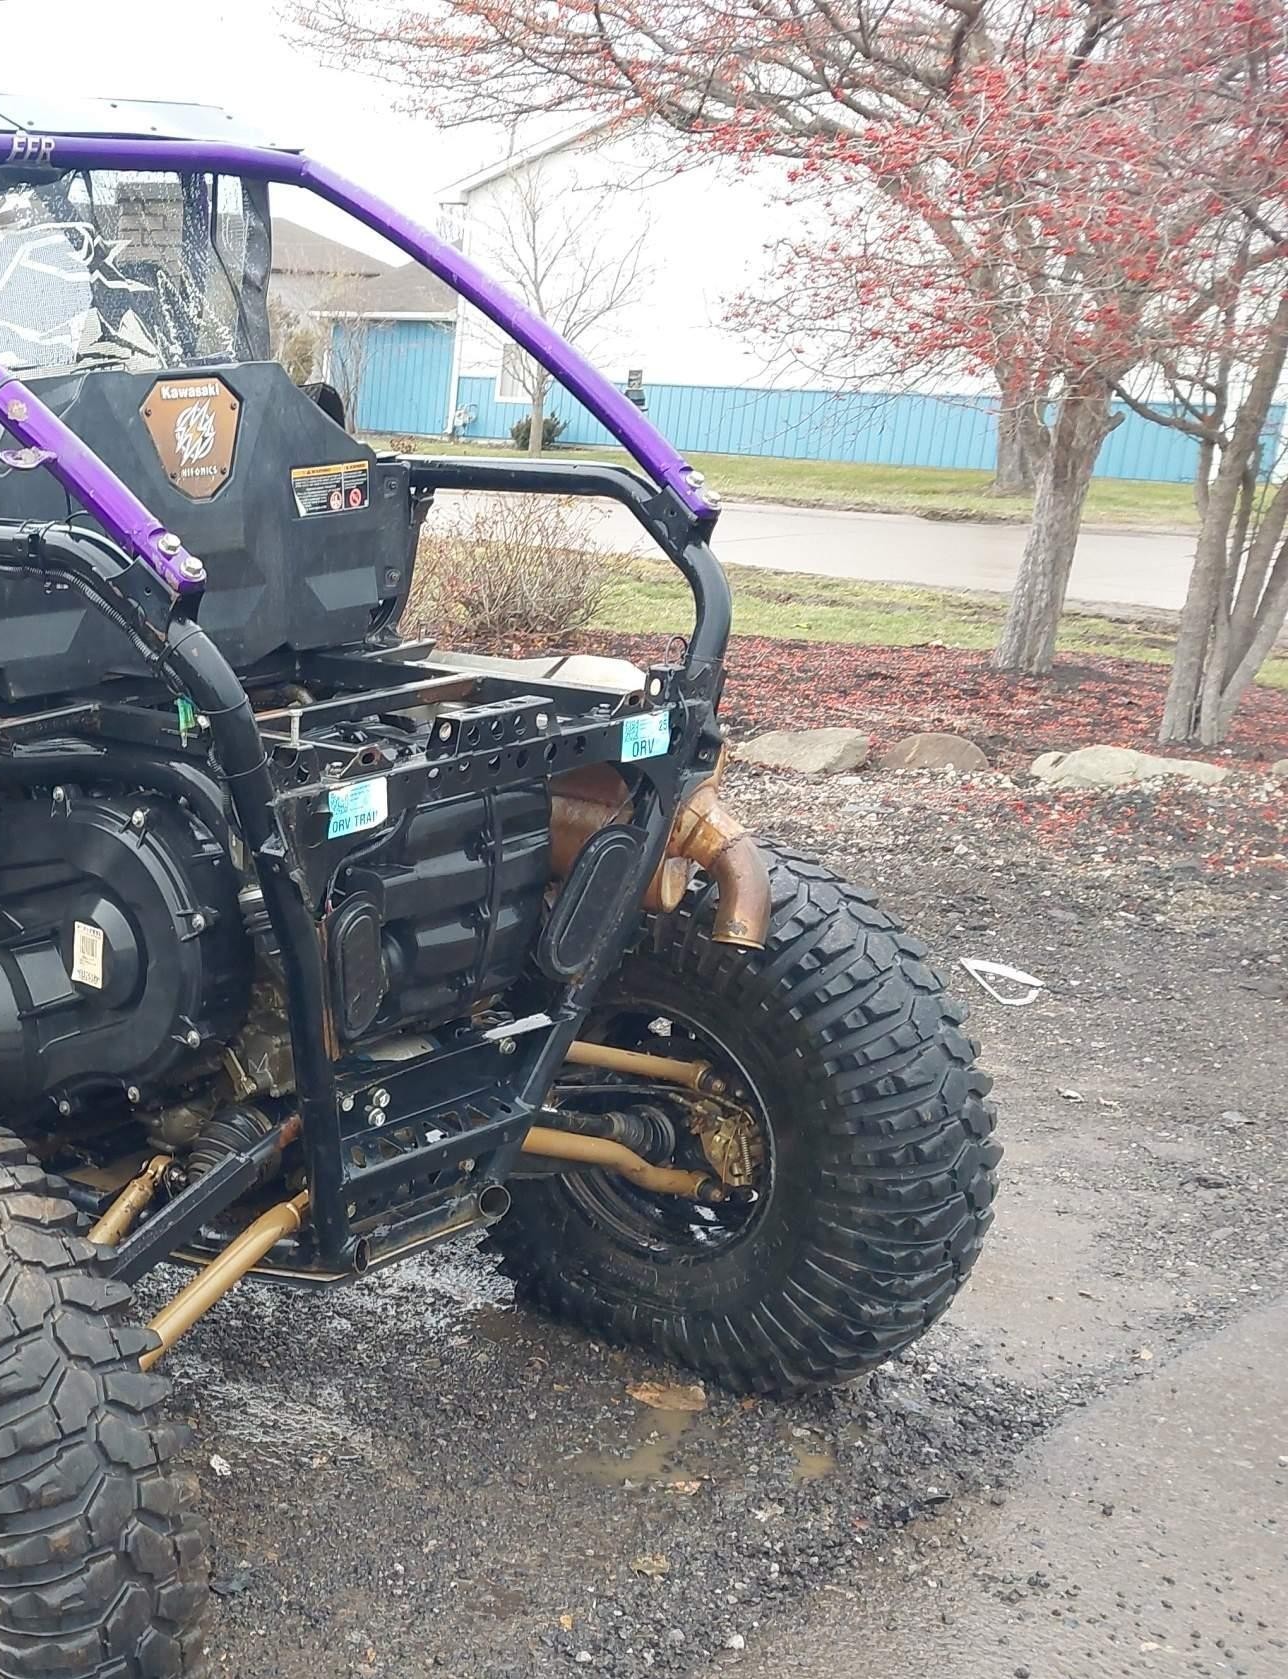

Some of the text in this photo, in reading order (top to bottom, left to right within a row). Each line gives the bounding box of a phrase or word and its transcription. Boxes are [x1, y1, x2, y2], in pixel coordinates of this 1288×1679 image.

[161, 383, 220, 400] Kawasaki
[632, 738, 655, 758] ORV
[332, 817, 351, 833] ORV
